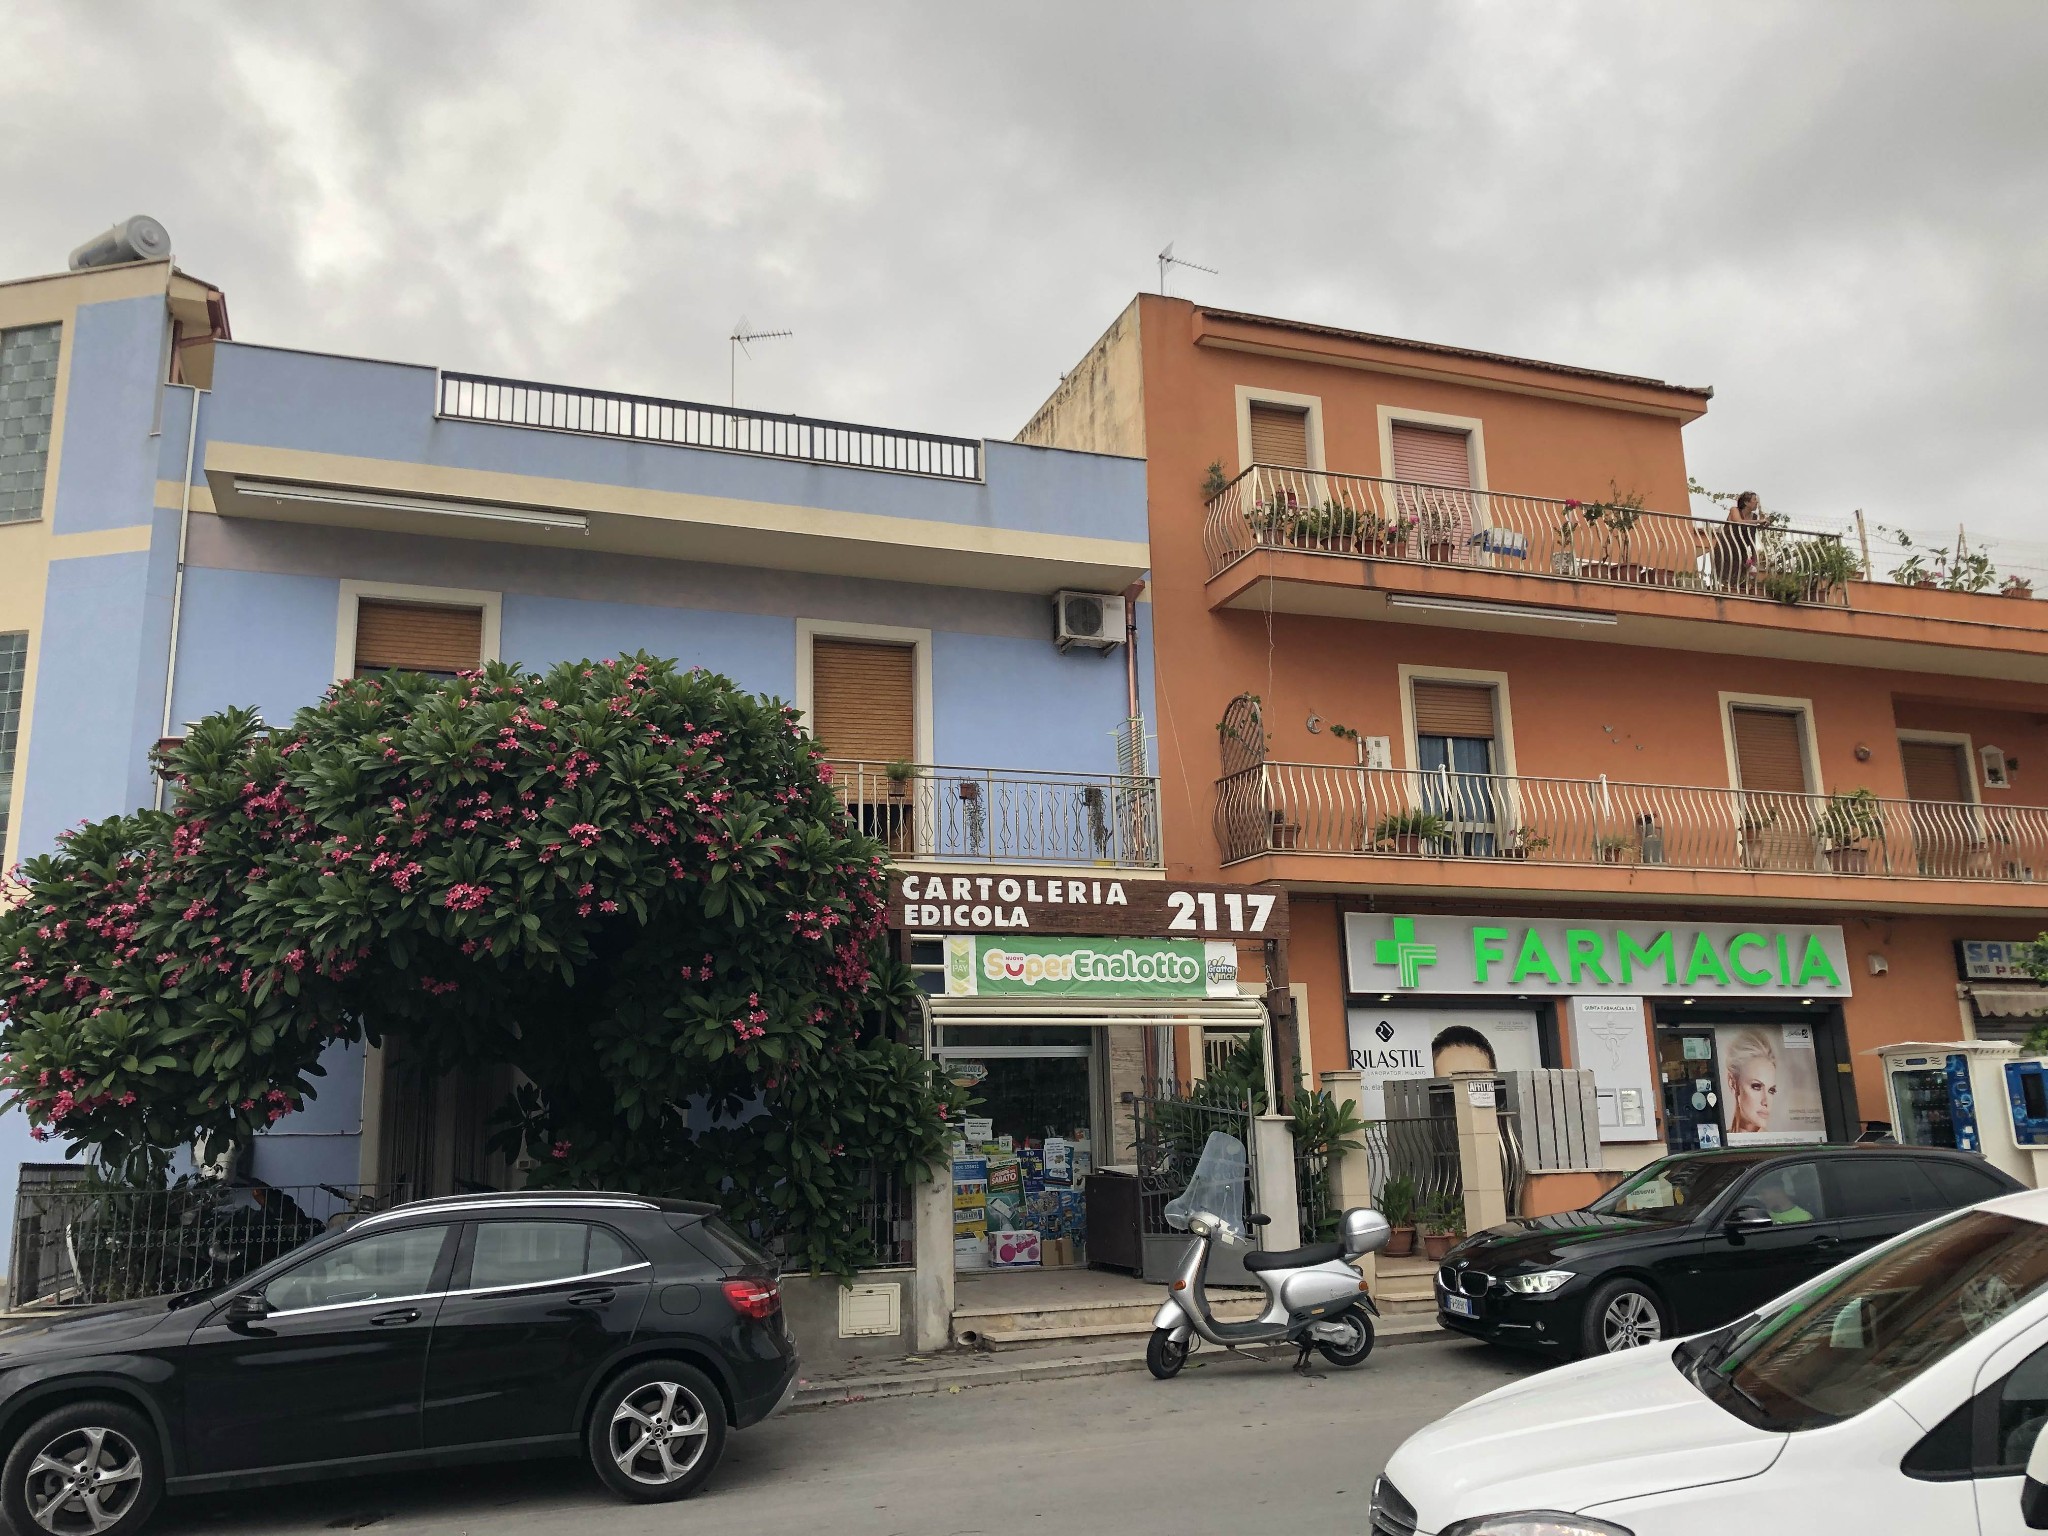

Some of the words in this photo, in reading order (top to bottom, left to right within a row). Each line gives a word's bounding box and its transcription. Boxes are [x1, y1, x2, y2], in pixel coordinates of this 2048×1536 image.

[902, 875, 1128, 906] CARTOLERIA
[904, 904, 1030, 928] EDICOLA
[1167, 891, 1276, 932] 2117
[952, 964, 968, 973] PAY
[1471, 926, 1843, 987] FARMACIA
[1208, 964, 1234, 974] Gratta
[1350, 1049, 1425, 1070] RILASTIL
